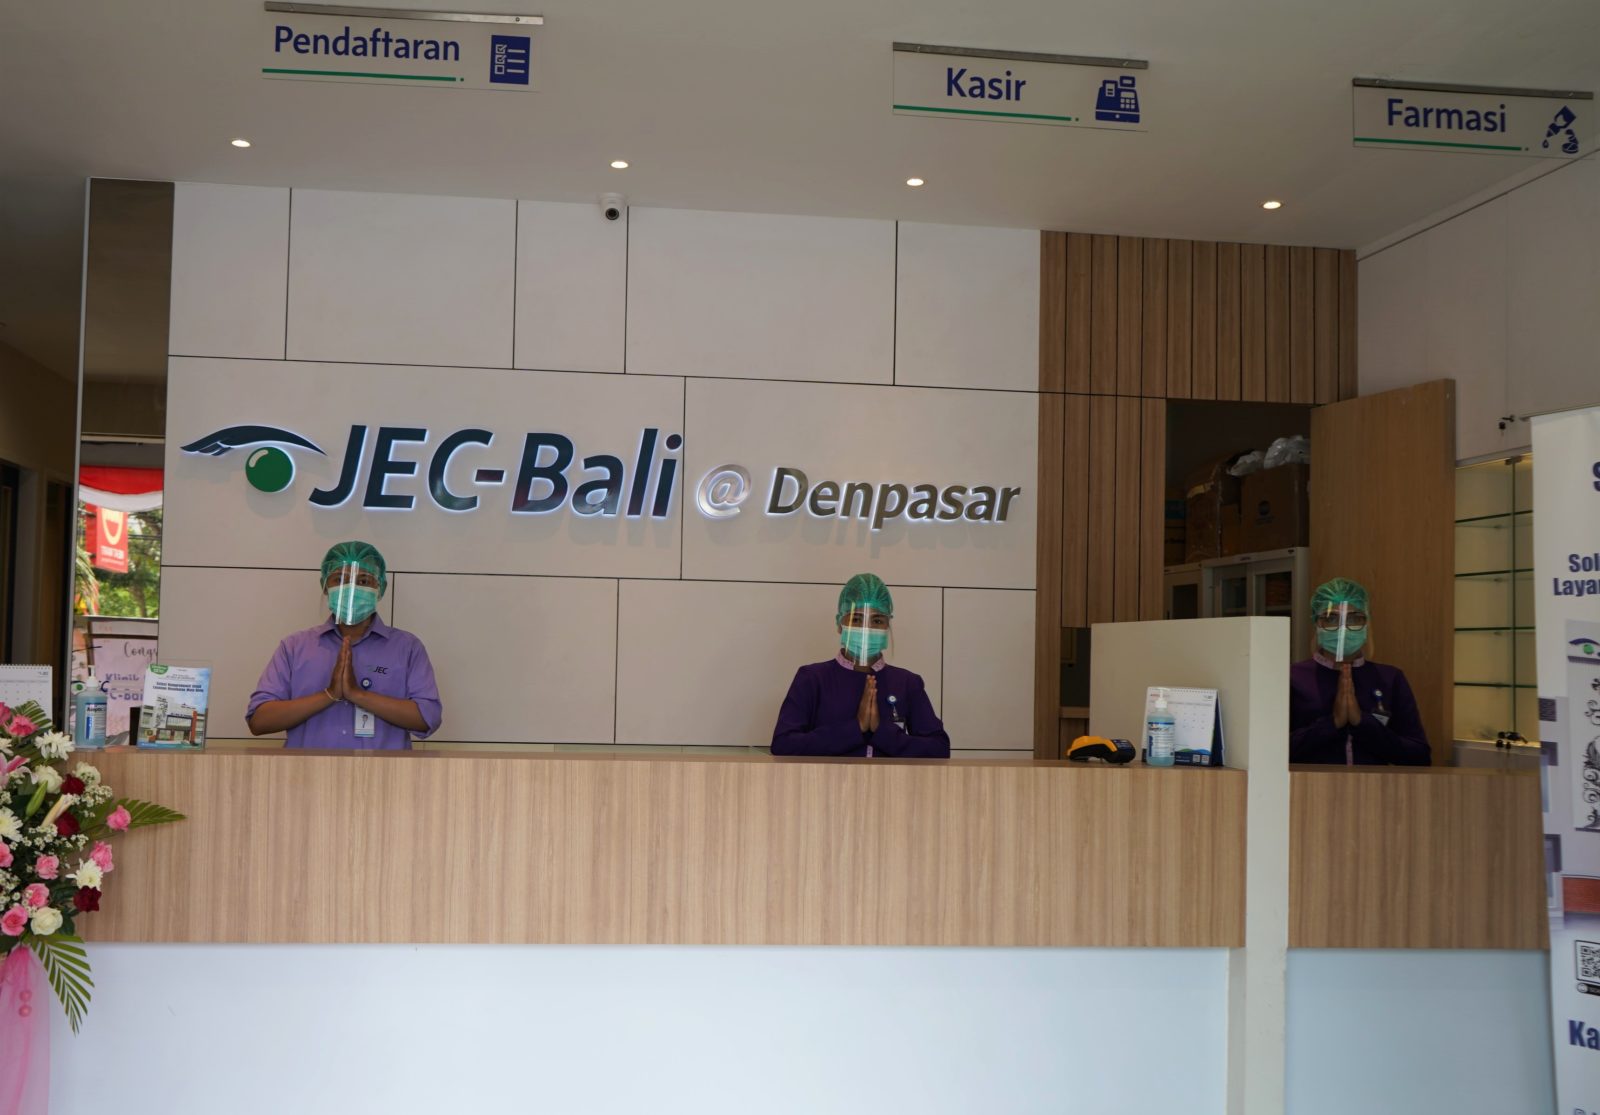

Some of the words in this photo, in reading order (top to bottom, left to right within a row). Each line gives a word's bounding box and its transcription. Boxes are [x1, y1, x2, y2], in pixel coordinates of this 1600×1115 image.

[273, 25, 461, 62] Pendaftaran
[946, 67, 1027, 101] Kasir
[1387, 98, 1506, 132] Farmasi
[308, 424, 683, 518] JEC-Bali
[697, 464, 751, 518] @
[766, 467, 1022, 530] Denpasar
[1553, 577, 1600, 597] Laya
[373, 666, 389, 675] JEC
